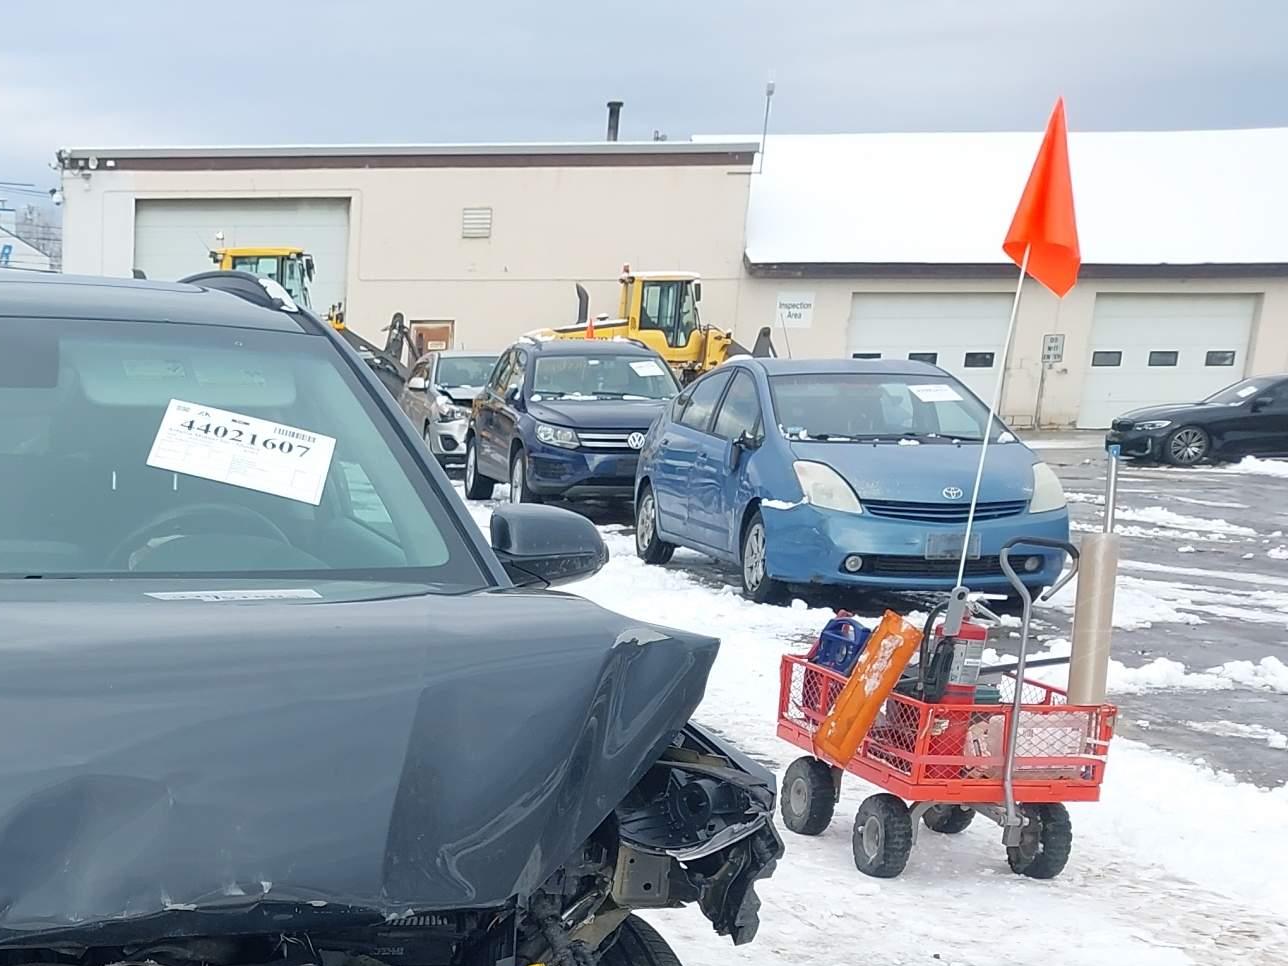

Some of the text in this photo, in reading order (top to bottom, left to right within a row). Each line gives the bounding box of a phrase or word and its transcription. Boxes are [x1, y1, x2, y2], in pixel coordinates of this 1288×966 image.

[778, 302, 812, 310] Inspection
[786, 311, 802, 319] Area
[180, 419, 311, 458] 44021607
